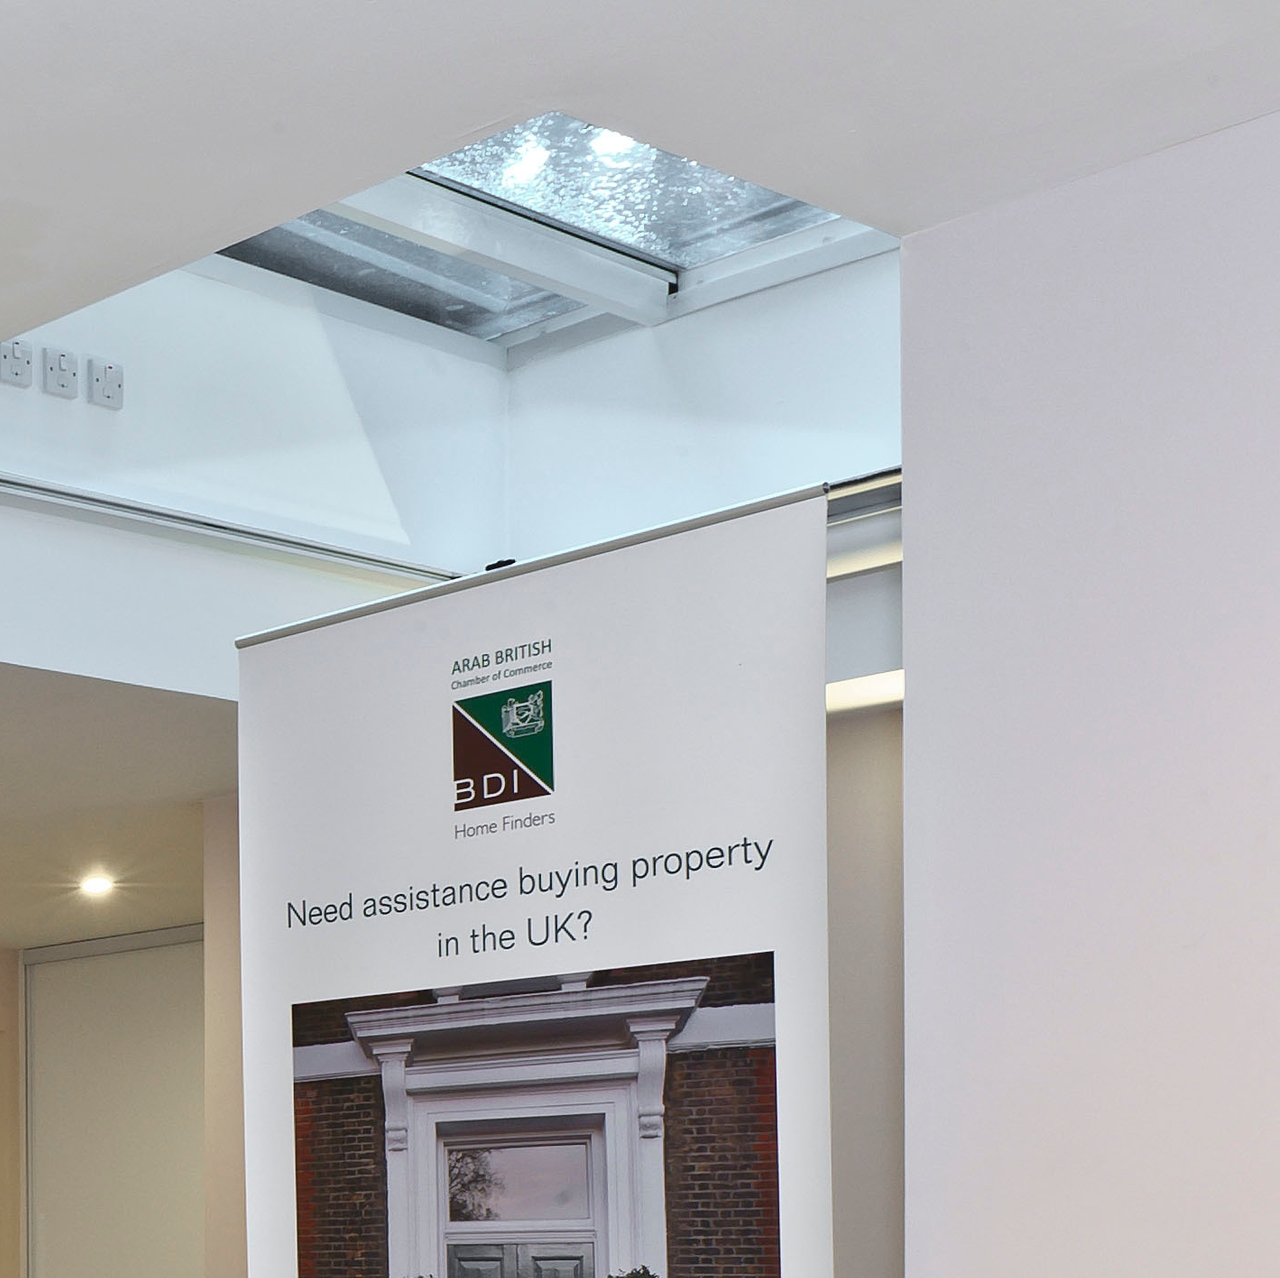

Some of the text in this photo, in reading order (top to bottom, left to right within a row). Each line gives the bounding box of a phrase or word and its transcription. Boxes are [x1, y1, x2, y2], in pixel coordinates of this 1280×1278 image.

[451, 638, 551, 674] ARAB BRITISH
[451, 661, 552, 689] Chamber of Commerce
[454, 769, 519, 804] BDI
[454, 812, 555, 838] Home Finders
[287, 836, 773, 928] Need assistance buying property
[438, 910, 592, 957] in the UK?
